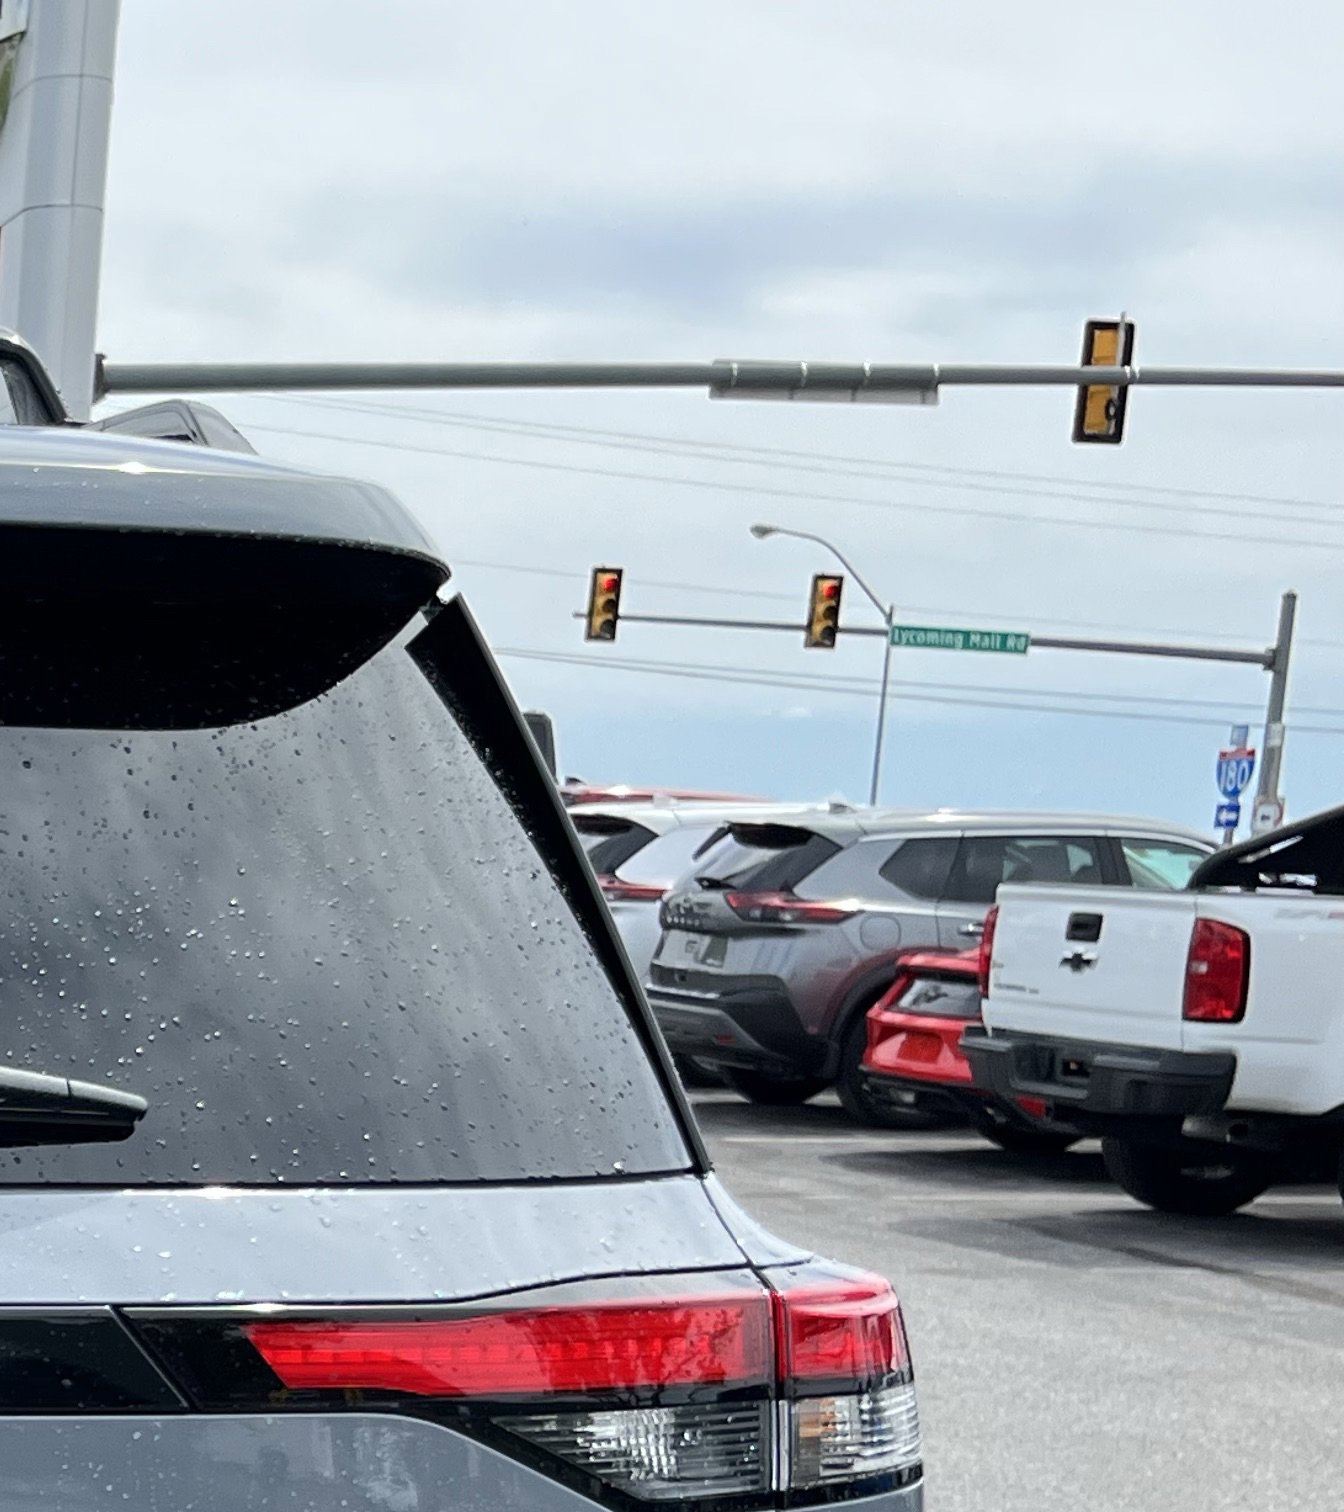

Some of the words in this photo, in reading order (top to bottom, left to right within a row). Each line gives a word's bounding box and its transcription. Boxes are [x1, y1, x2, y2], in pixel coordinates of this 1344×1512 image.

[894, 627, 964, 649] Lycoming
[968, 631, 1002, 650] Mall
[1006, 633, 1027, 651] Rd
